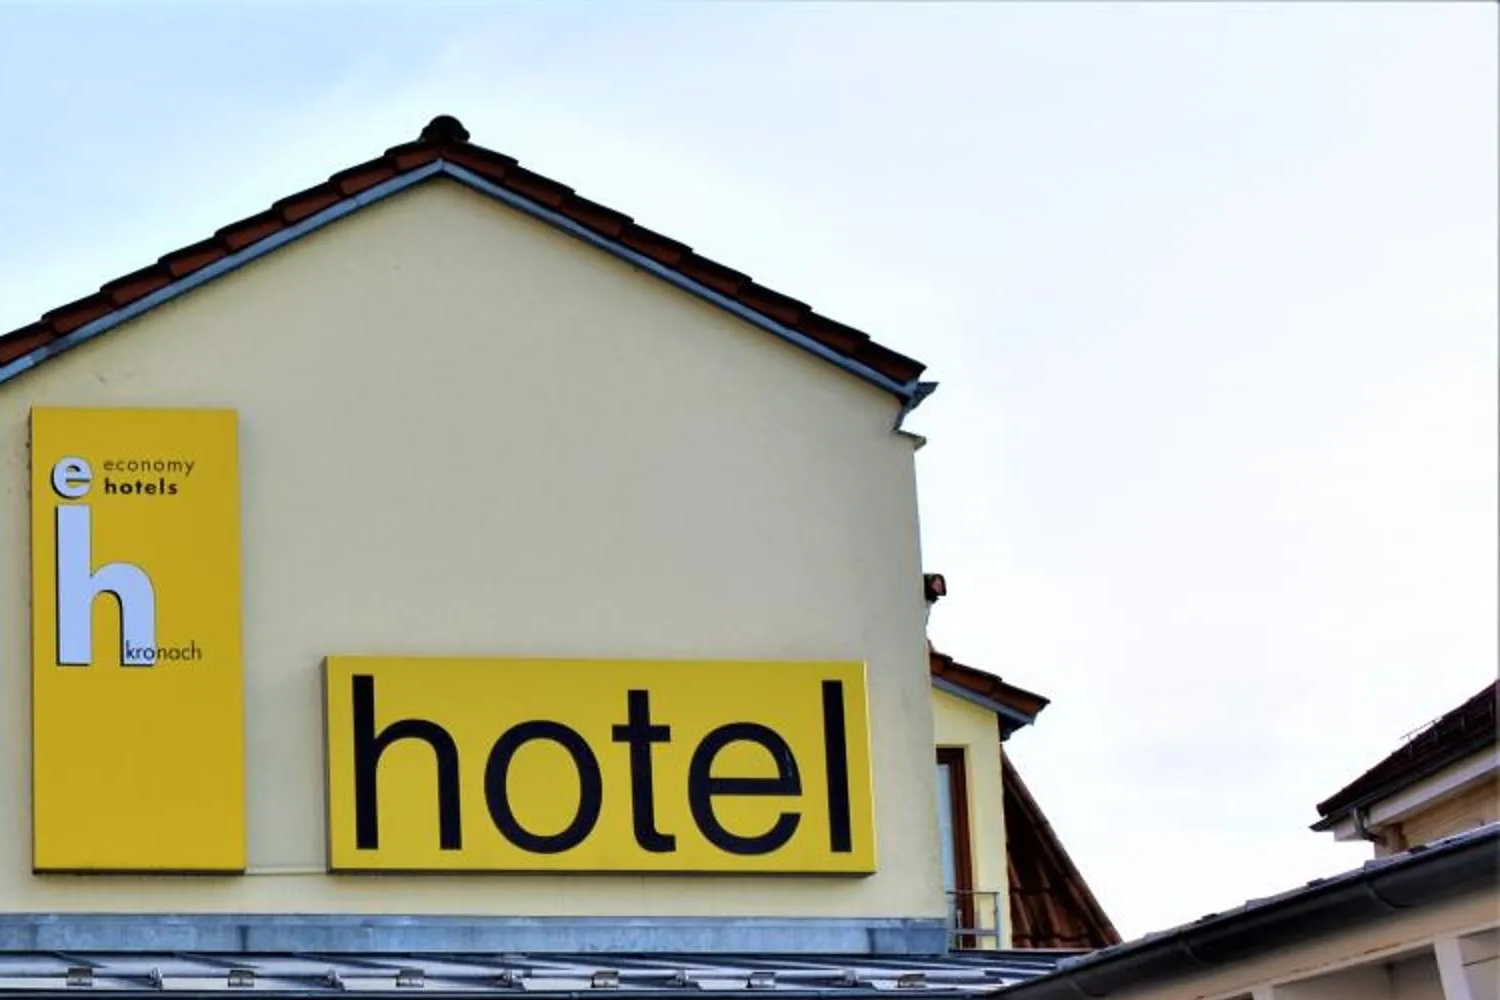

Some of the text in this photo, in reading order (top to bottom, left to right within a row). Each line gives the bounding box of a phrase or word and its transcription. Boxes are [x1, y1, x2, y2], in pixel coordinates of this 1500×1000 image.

[51, 456, 92, 499] e
[103, 458, 195, 477] economy
[104, 478, 178, 495] hotels
[55, 504, 156, 667] h
[125, 640, 202, 661] kronach
[352, 674, 852, 856] hotel
